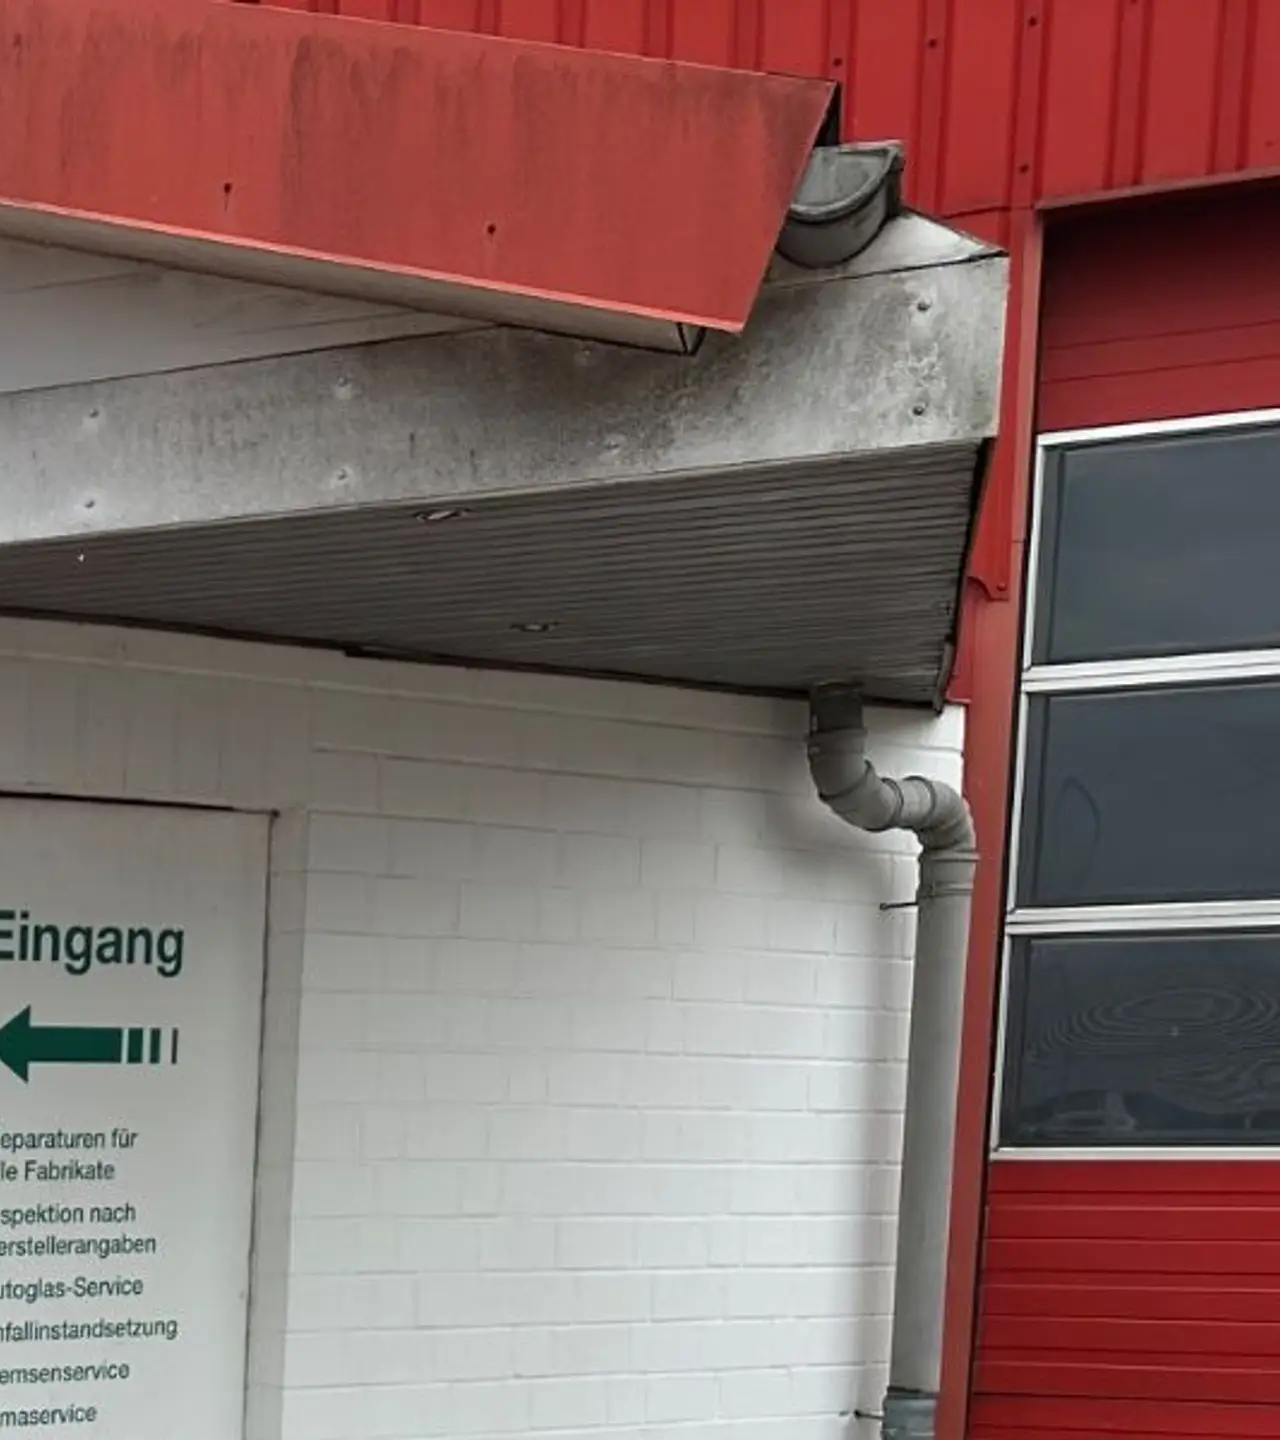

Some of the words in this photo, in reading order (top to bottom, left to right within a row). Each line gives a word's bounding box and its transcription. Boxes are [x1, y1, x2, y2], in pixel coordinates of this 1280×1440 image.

[111, 1128, 139, 1149] für
[24, 1160, 116, 1182] Fabrikate
[89, 1203, 136, 1223] nach
